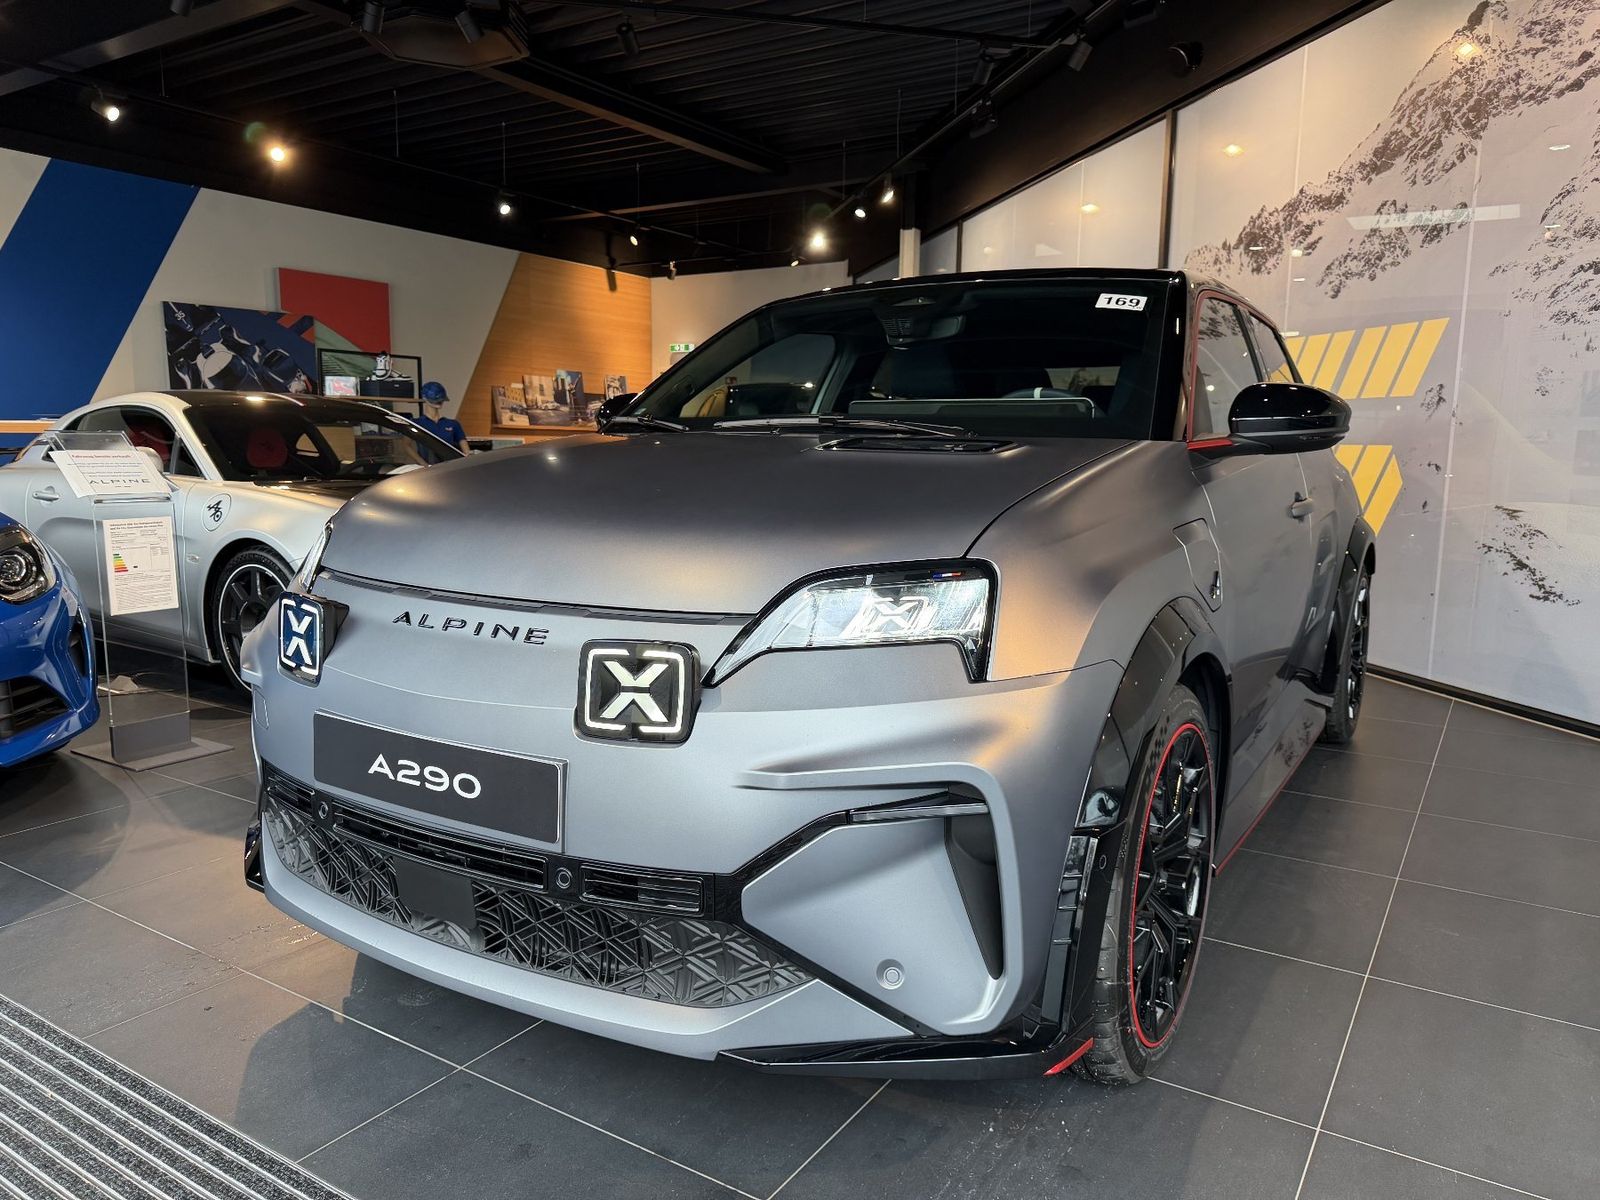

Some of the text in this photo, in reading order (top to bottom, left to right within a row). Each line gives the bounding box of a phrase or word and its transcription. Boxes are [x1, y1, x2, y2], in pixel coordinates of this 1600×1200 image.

[1104, 296, 1140, 307] 169
[392, 611, 550, 645] ALPINE
[367, 753, 482, 799] A290
